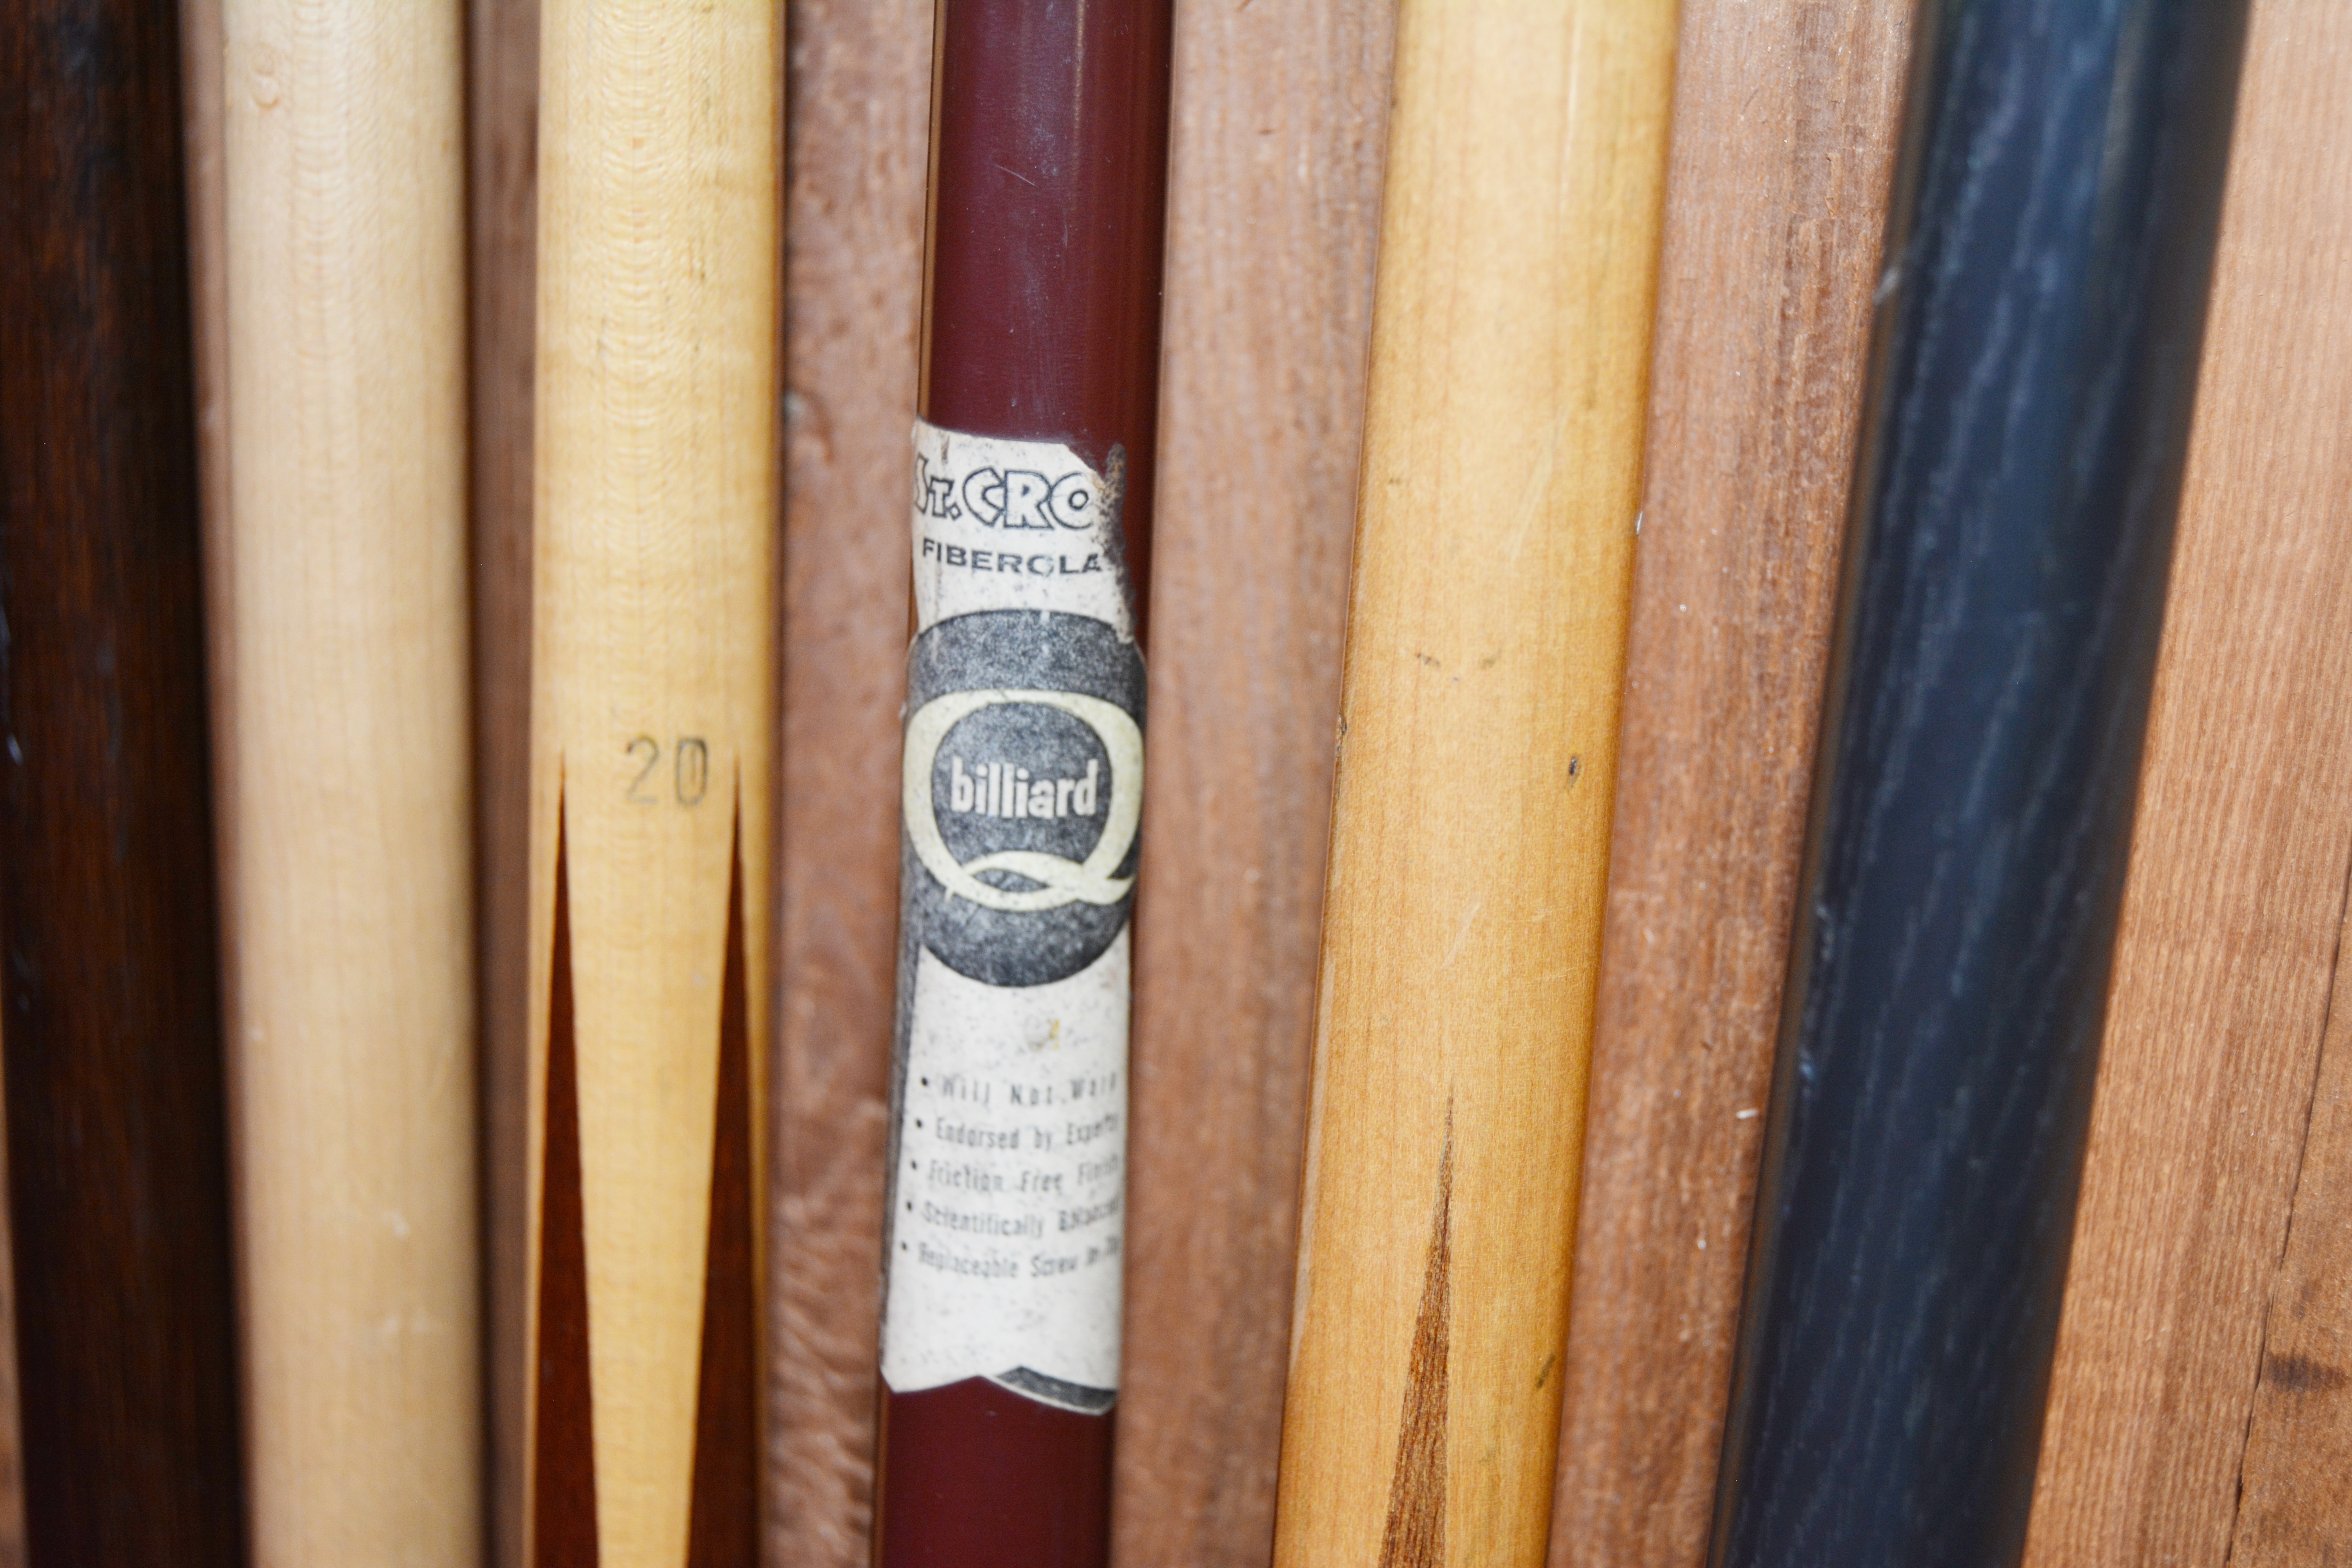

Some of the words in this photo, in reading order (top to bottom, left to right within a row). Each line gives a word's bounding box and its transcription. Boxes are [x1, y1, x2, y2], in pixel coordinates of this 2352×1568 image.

[626, 735, 708, 806] 20
[950, 755, 1098, 819] billiard
[902, 688, 1145, 912] Q
[937, 1073, 991, 1105] Will
[1010, 1083, 1054, 1105] Not
[935, 1116, 1020, 1150] Endorsed
[1033, 1125, 1052, 1152] by
[927, 1159, 1005, 1192] Friction
[1020, 1170, 1064, 1192] Free
